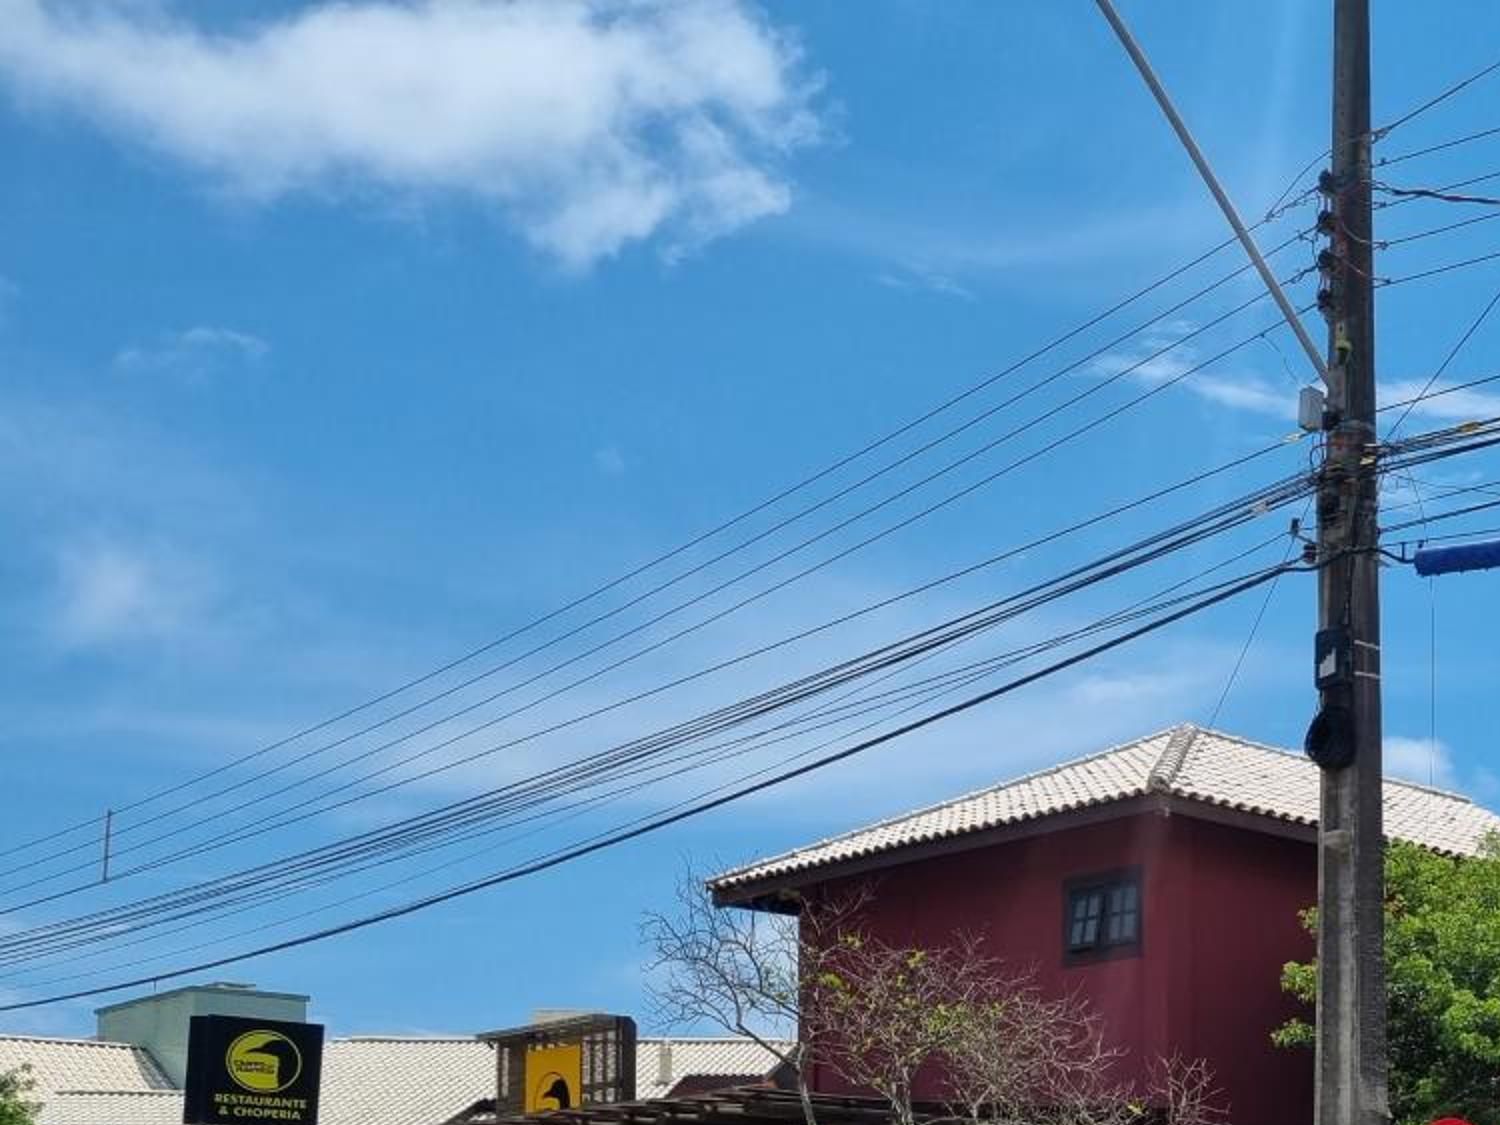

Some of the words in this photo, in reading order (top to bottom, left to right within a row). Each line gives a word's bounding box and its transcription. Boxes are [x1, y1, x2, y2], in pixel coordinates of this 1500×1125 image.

[214, 1093, 307, 1109] RESTAURANTE
[218, 1105, 229, 1115] &
[233, 1106, 301, 1120] CHOPERIA
